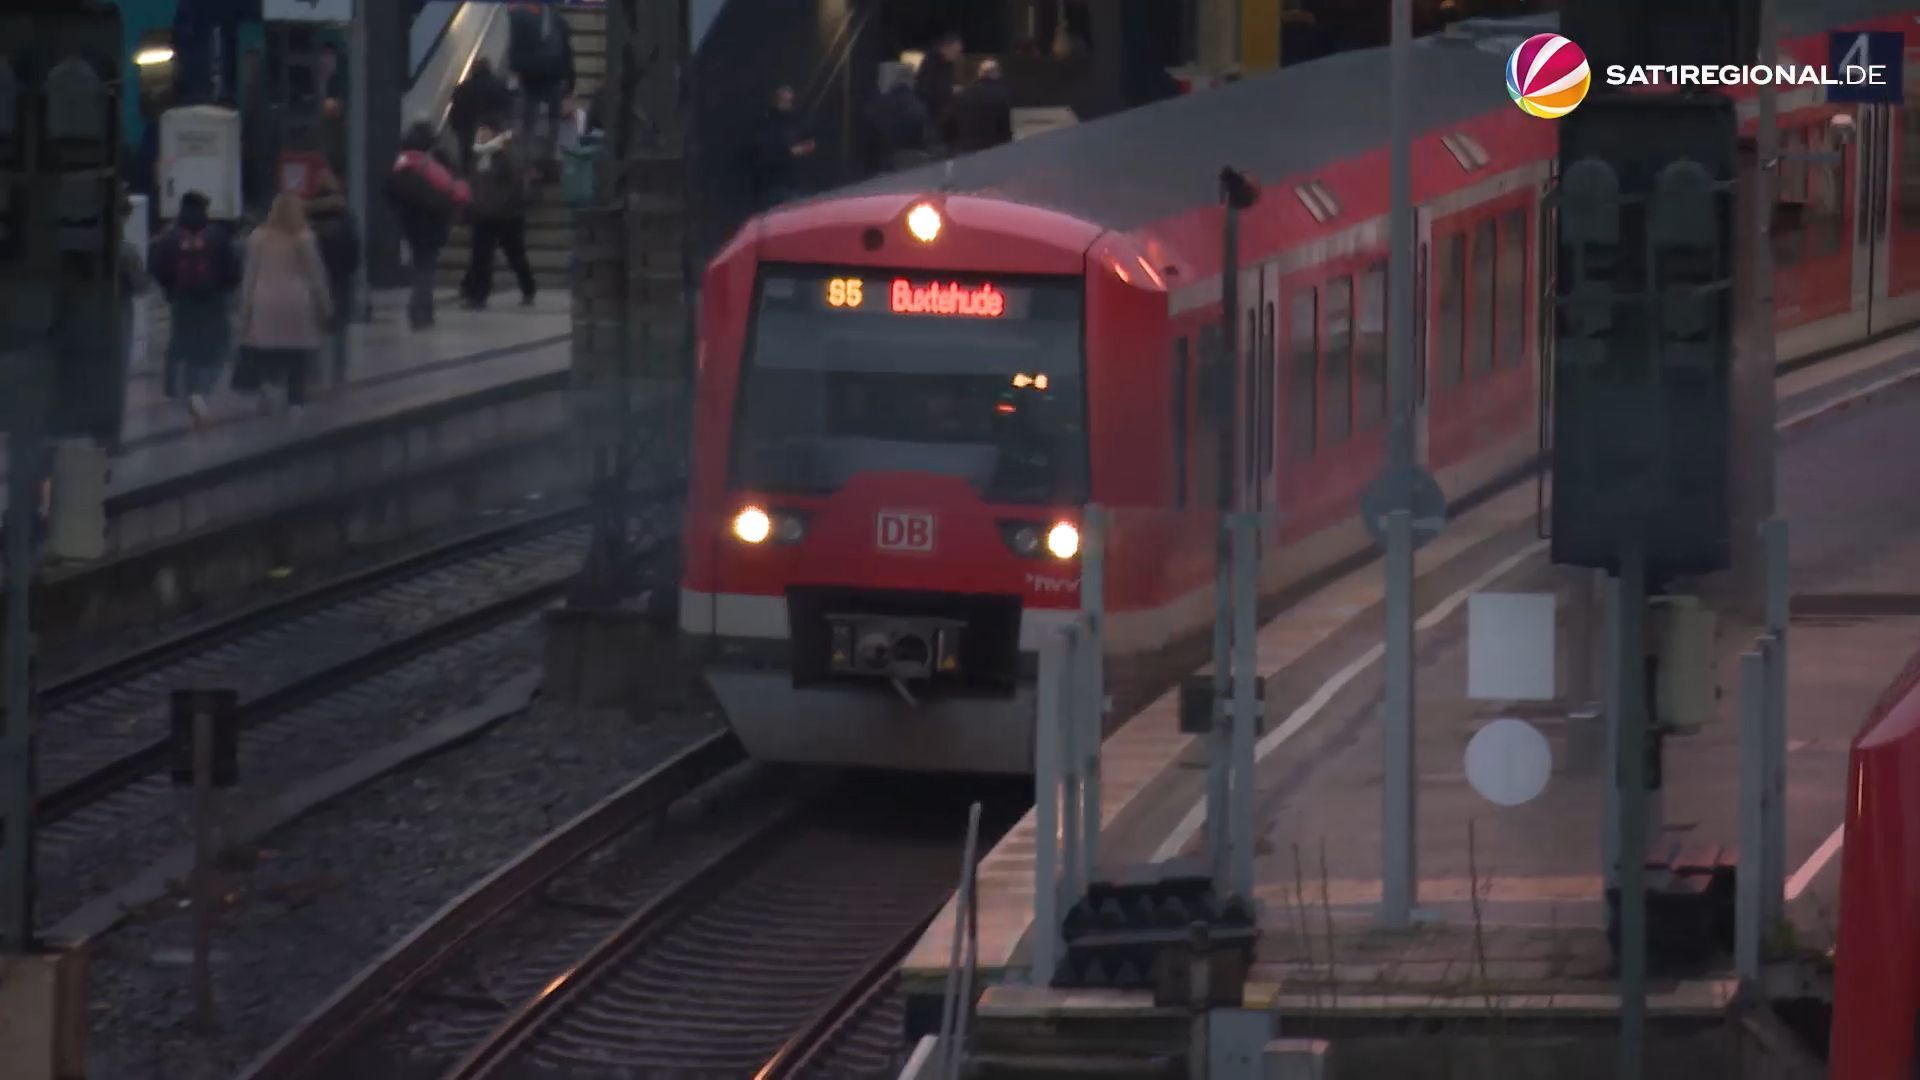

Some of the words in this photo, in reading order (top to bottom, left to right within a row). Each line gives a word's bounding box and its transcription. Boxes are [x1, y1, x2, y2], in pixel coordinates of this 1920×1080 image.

[1837, 32, 1873, 88] 4
[827, 277, 864, 307] S5
[891, 277, 1004, 317] Buxtehude
[880, 515, 931, 549] DB
